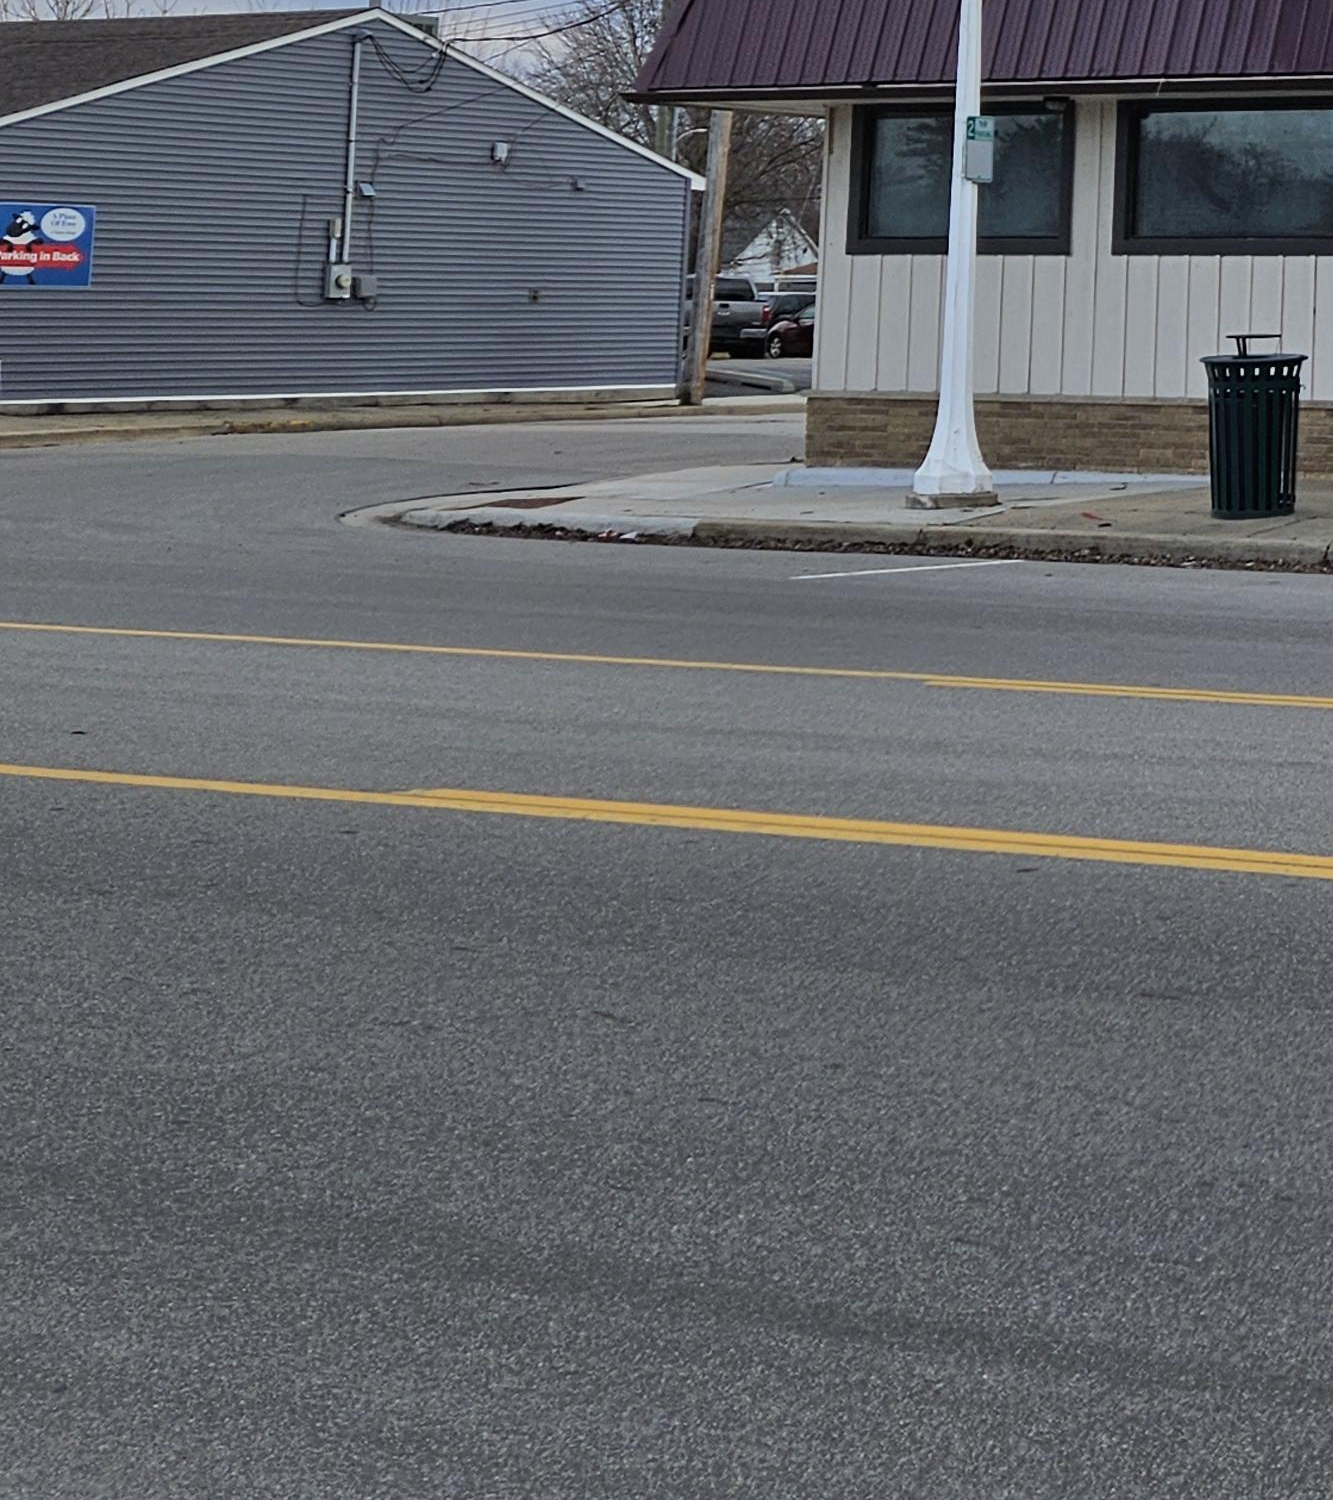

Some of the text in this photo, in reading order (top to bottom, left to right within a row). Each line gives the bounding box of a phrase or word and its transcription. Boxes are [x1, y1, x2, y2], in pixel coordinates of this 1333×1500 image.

[967, 120, 974, 136] 2
[40, 251, 51, 261] in
[52, 252, 80, 262] Back
